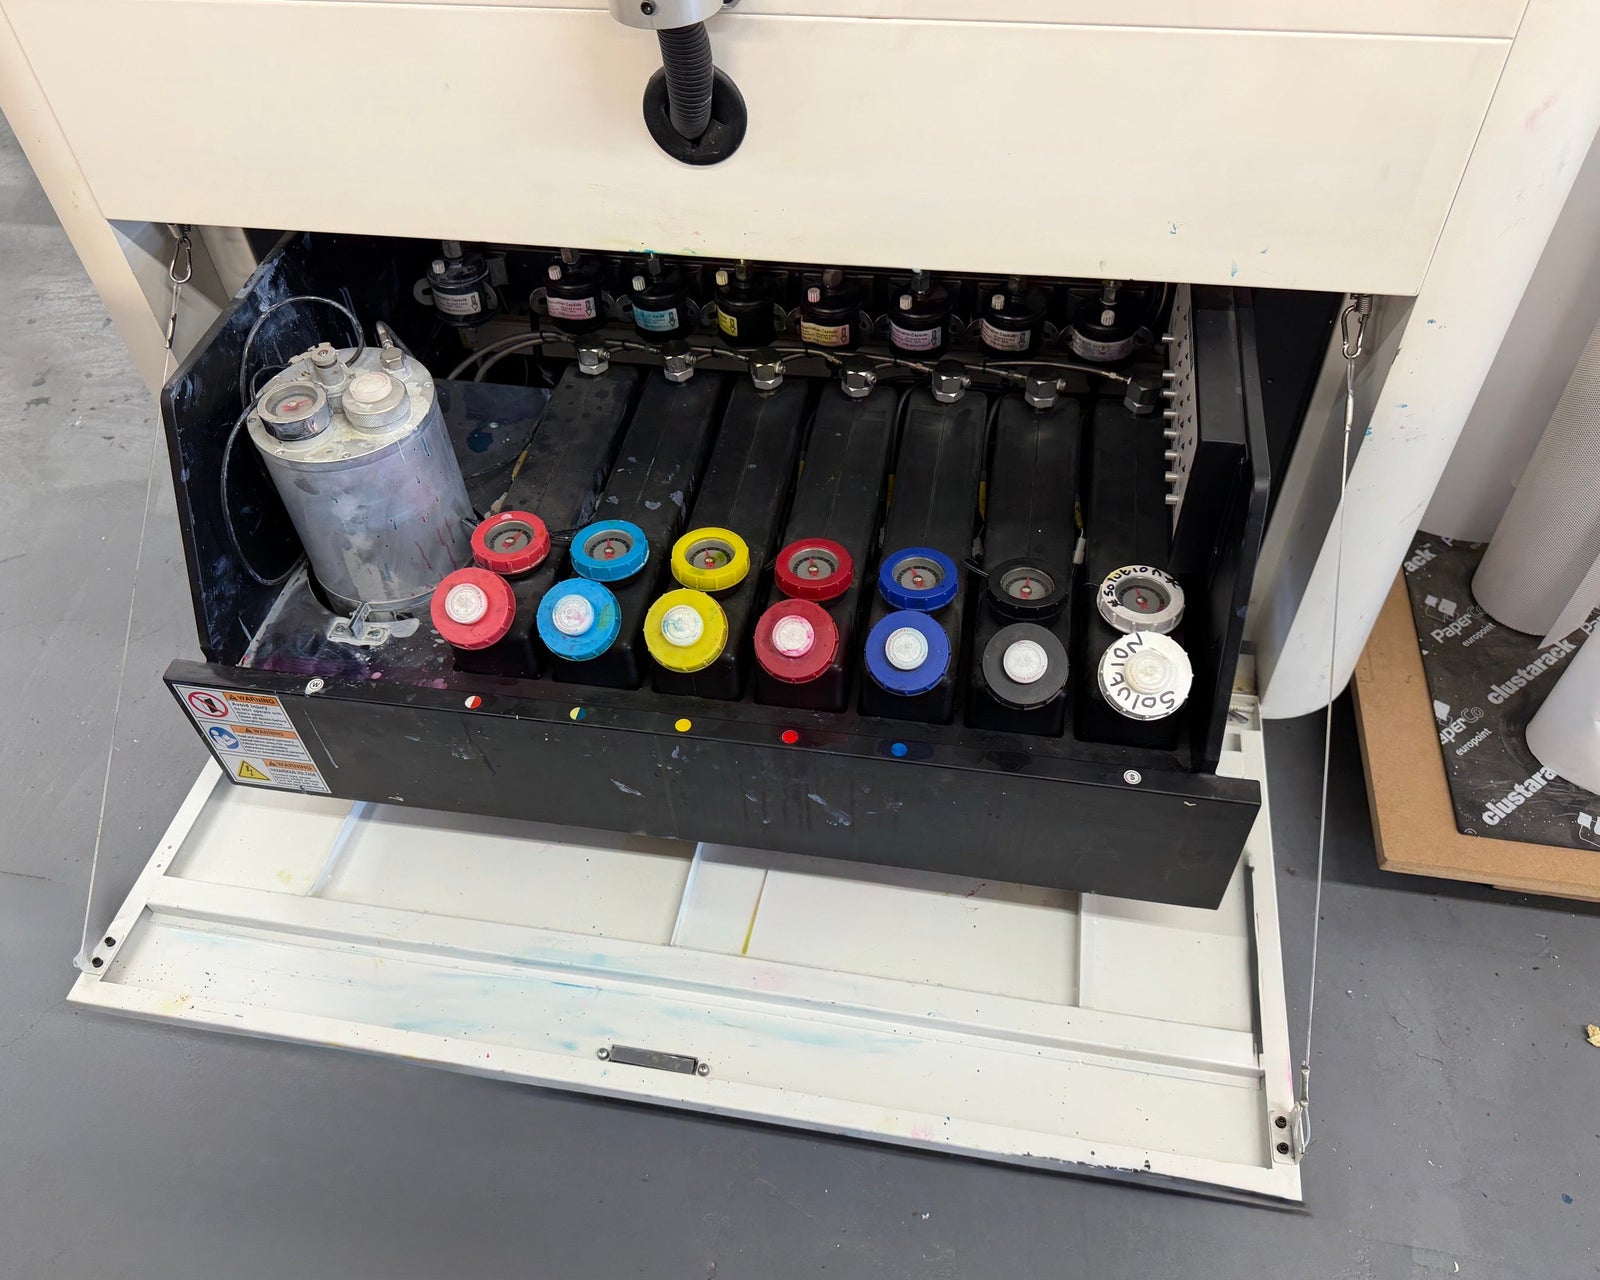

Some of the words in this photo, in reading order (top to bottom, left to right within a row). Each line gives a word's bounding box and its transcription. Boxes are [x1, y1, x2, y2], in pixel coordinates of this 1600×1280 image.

[1487, 637, 1578, 706] clustarack
[237, 695, 275, 704] WARNING
[252, 728, 284, 737] WARNING
[1456, 727, 1493, 756] europoint
[277, 761, 312, 771] WARNING
